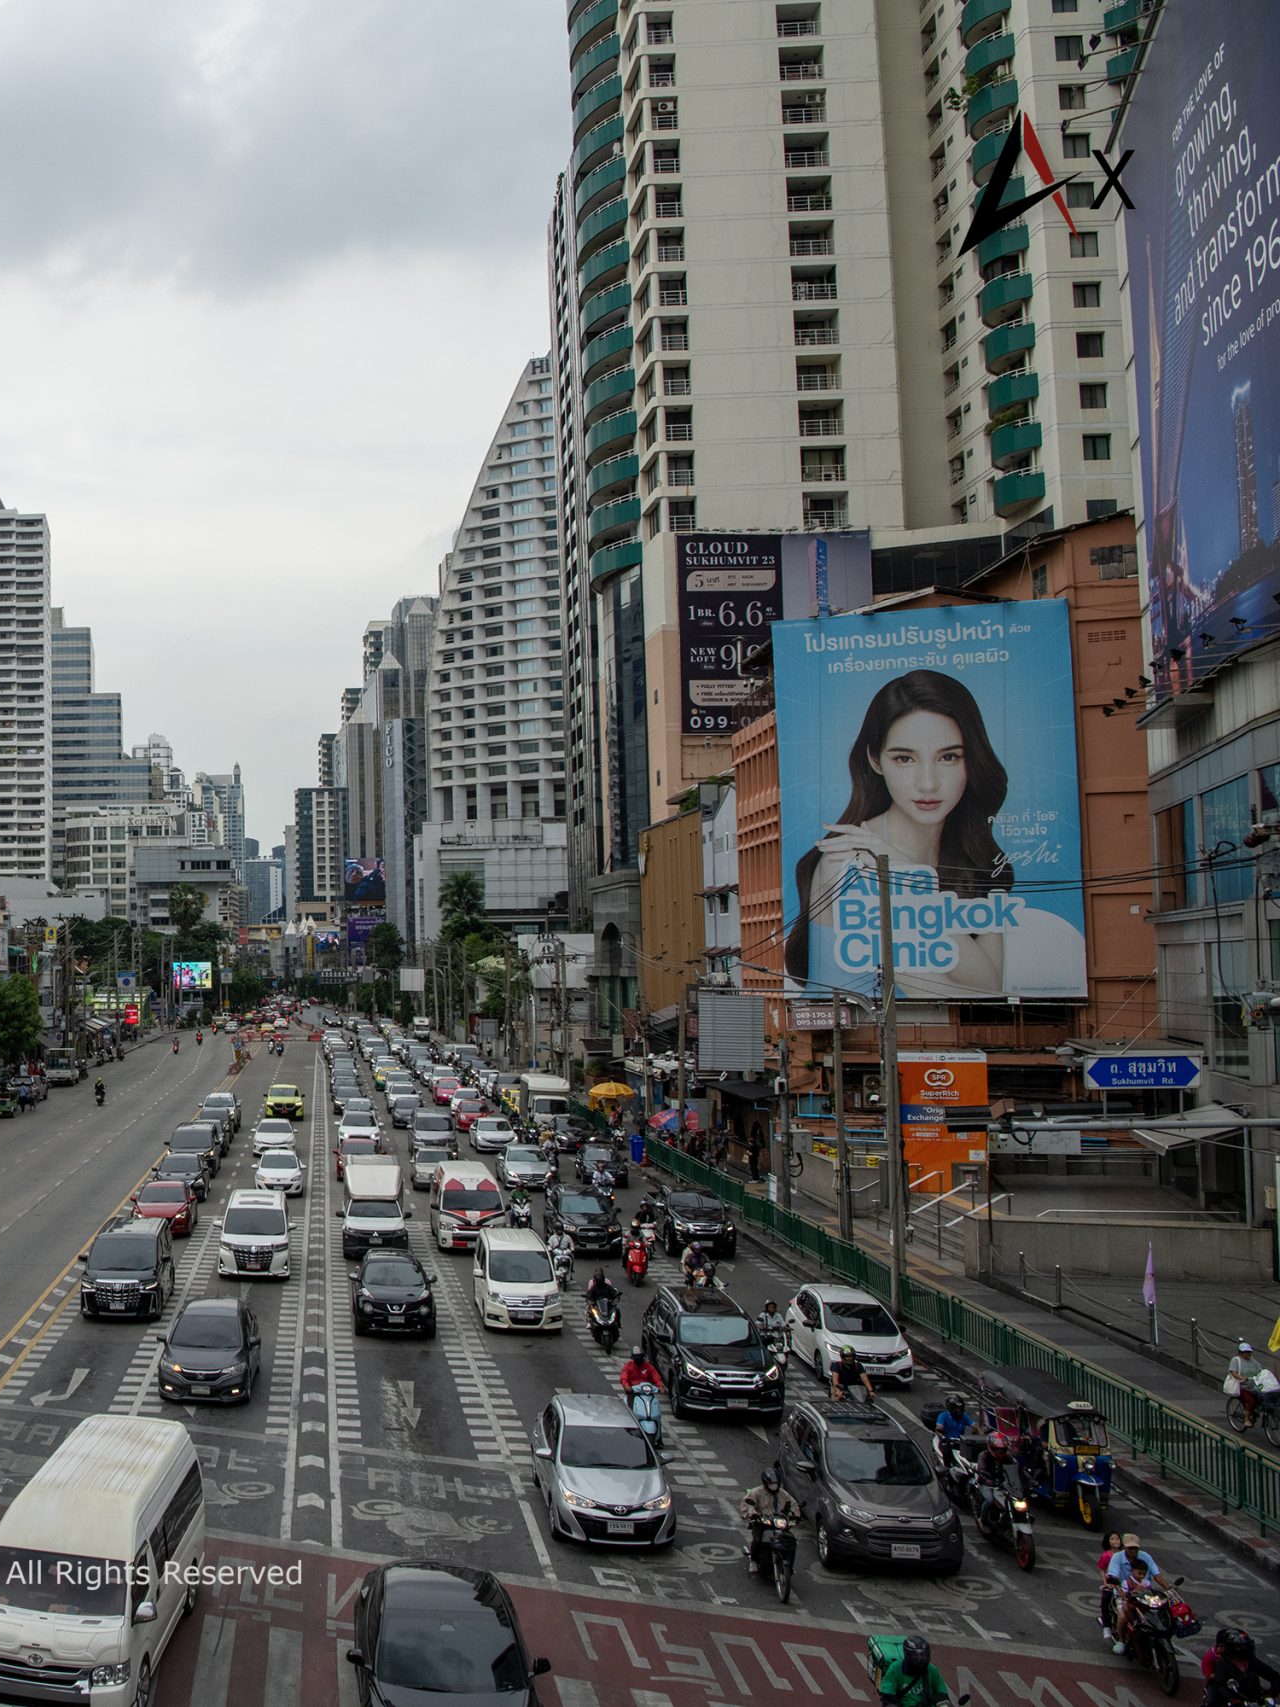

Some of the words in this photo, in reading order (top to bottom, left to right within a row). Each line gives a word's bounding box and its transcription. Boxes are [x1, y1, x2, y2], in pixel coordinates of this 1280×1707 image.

[1171, 122, 1184, 148] FOR
[1182, 101, 1196, 126] THE
[1194, 69, 1214, 106] LOVE
[1214, 42, 1226, 65] OF
[1174, 82, 1238, 207] growing,
[1187, 124, 1257, 239] thriving,
[1174, 267, 1197, 327] and
[1201, 273, 1242, 347] since
[1226, 337, 1240, 364] the
[1238, 321, 1256, 356] love
[1256, 308, 1266, 336] of
[685, 541, 749, 555] CLOUD
[685, 556, 758, 566] SUKHUMVIT
[762, 556, 776, 565] 23
[695, 574, 704, 588] 5
[718, 600, 763, 627] 6.6
[690, 648, 717, 656] NEW
[803, 619, 1005, 653] โปรแกรมปรับรูปหน้า
[1008, 624, 1032, 635] ด้วย
[827, 652, 948, 675] เครื่องยกกระชับ
[952, 648, 1010, 670] ดูแลผิว
[840, 864, 934, 897] Aura
[839, 895, 1020, 939] Bangkok
[839, 932, 953, 968] Clnic
[1111, 1077, 1154, 1085] Sukhumvit
[1161, 1077, 1176, 1085] Rd.
[1128, 1057, 1177, 1077] สุขุมวิท
[920, 1089, 960, 1097] SuperRich
